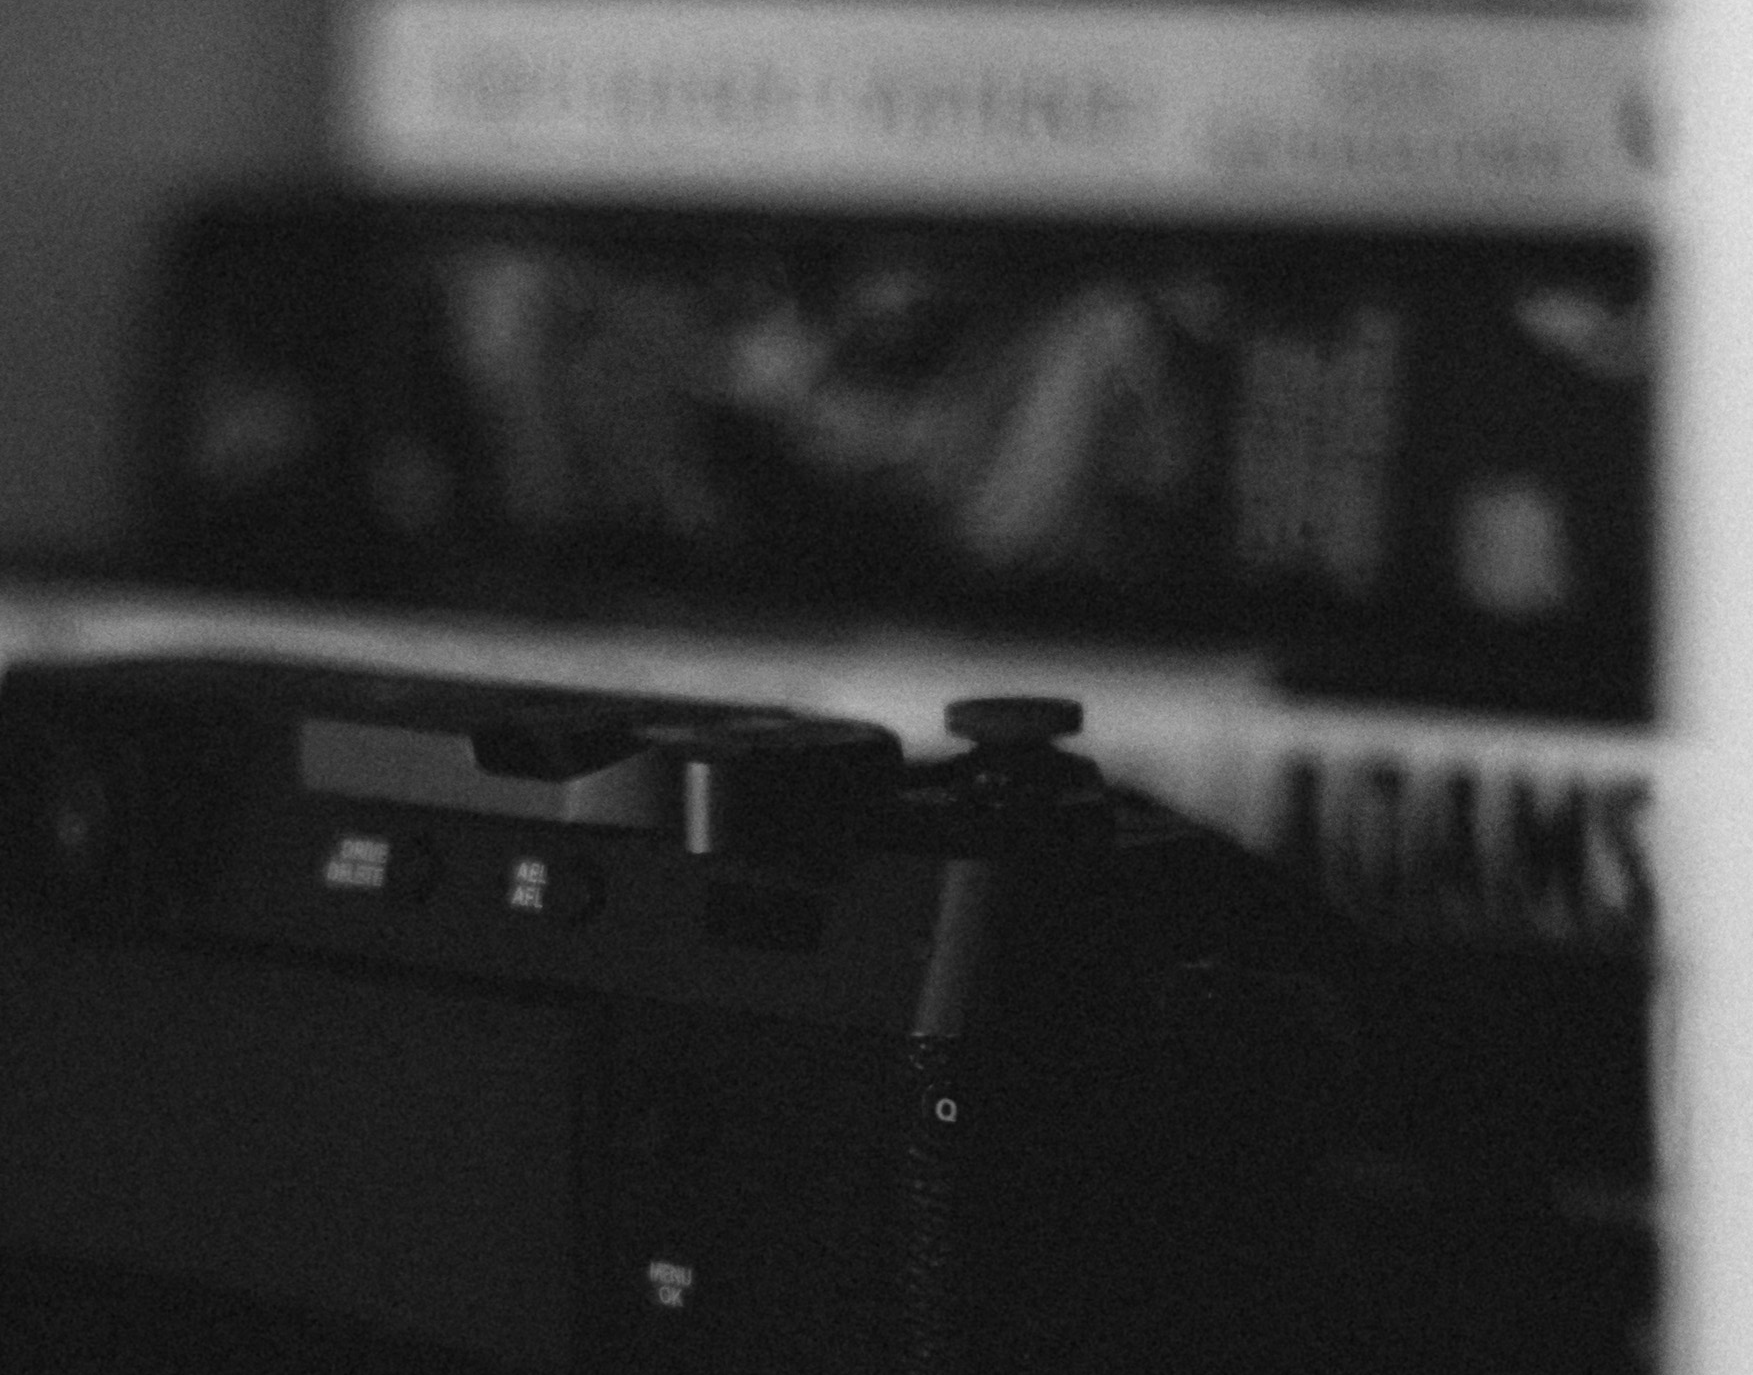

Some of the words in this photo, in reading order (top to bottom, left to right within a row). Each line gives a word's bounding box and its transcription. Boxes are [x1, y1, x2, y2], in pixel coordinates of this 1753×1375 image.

[514, 861, 546, 885] AEL
[510, 884, 543, 908] AFL
[934, 1096, 959, 1124] Q
[649, 1262, 693, 1286] MENU
[658, 1286, 684, 1307] OK
